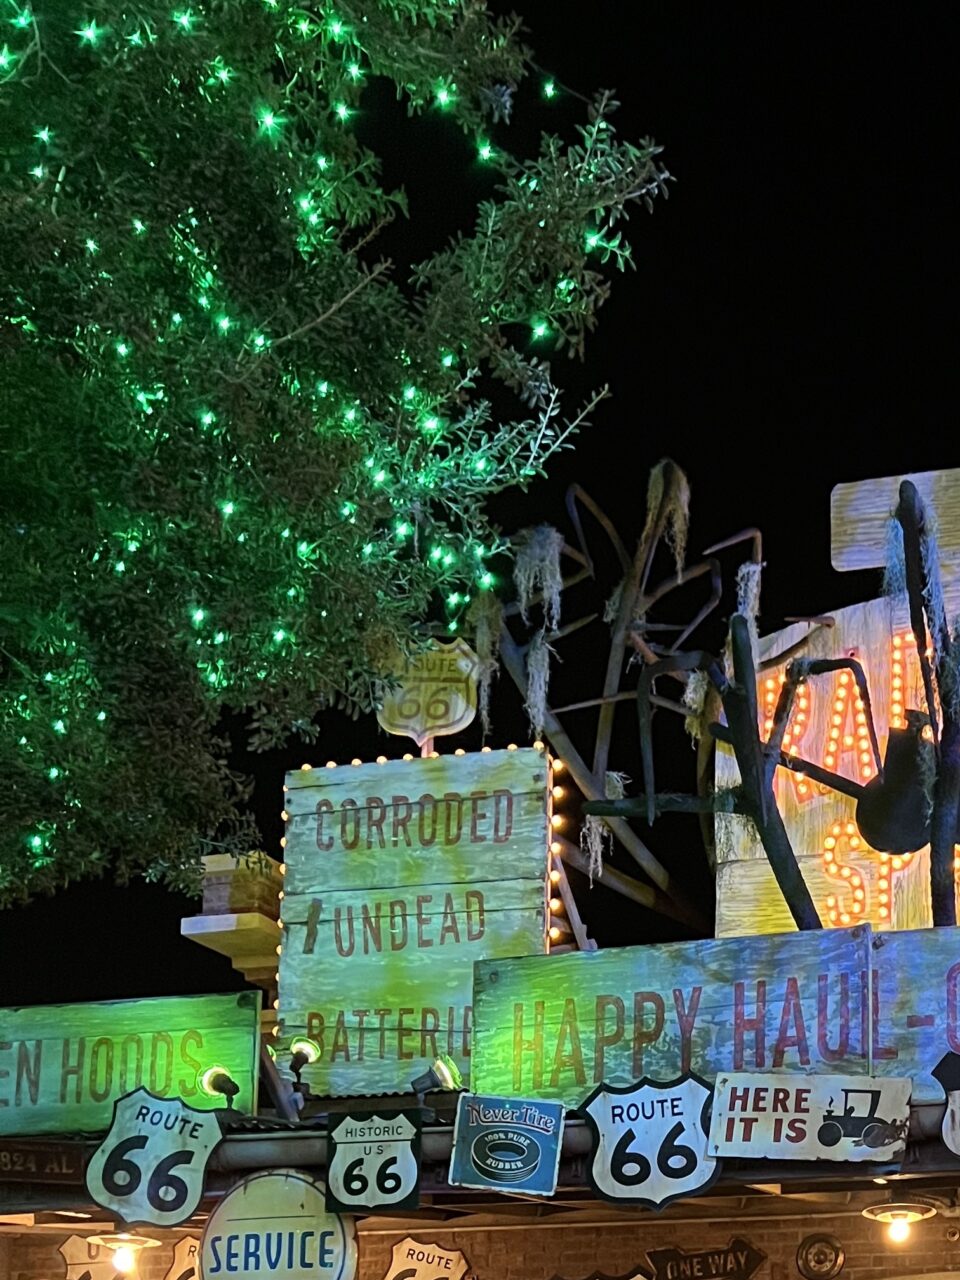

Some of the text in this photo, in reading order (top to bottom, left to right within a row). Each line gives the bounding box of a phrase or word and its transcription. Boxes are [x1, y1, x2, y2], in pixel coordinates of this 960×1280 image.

[397, 686, 451, 720] 66
[315, 788, 514, 852] CORRODED
[333, 890, 486, 958] UNDEAD
[512, 985, 703, 1093] HAPPY
[60, 1028, 204, 1105] HOODS
[465, 1103, 556, 1130] Never Tire
[610, 1096, 684, 1124] ROUTE
[729, 1086, 811, 1115] HERE
[135, 1105, 204, 1139] ROUTE
[344, 1123, 404, 1138] HISTORIC
[725, 1117, 808, 1144] IT IS
[508, 1132, 531, 1147] PURE
[610, 1122, 699, 1187] 66
[102, 1135, 195, 1213] 66
[342, 1156, 403, 1196] 66
[486, 1157, 524, 1169] RUBBER
[208, 1230, 336, 1274] SERVICE
[405, 1247, 454, 1270] ROUTE
[665, 1250, 749, 1280] ONE WAY
